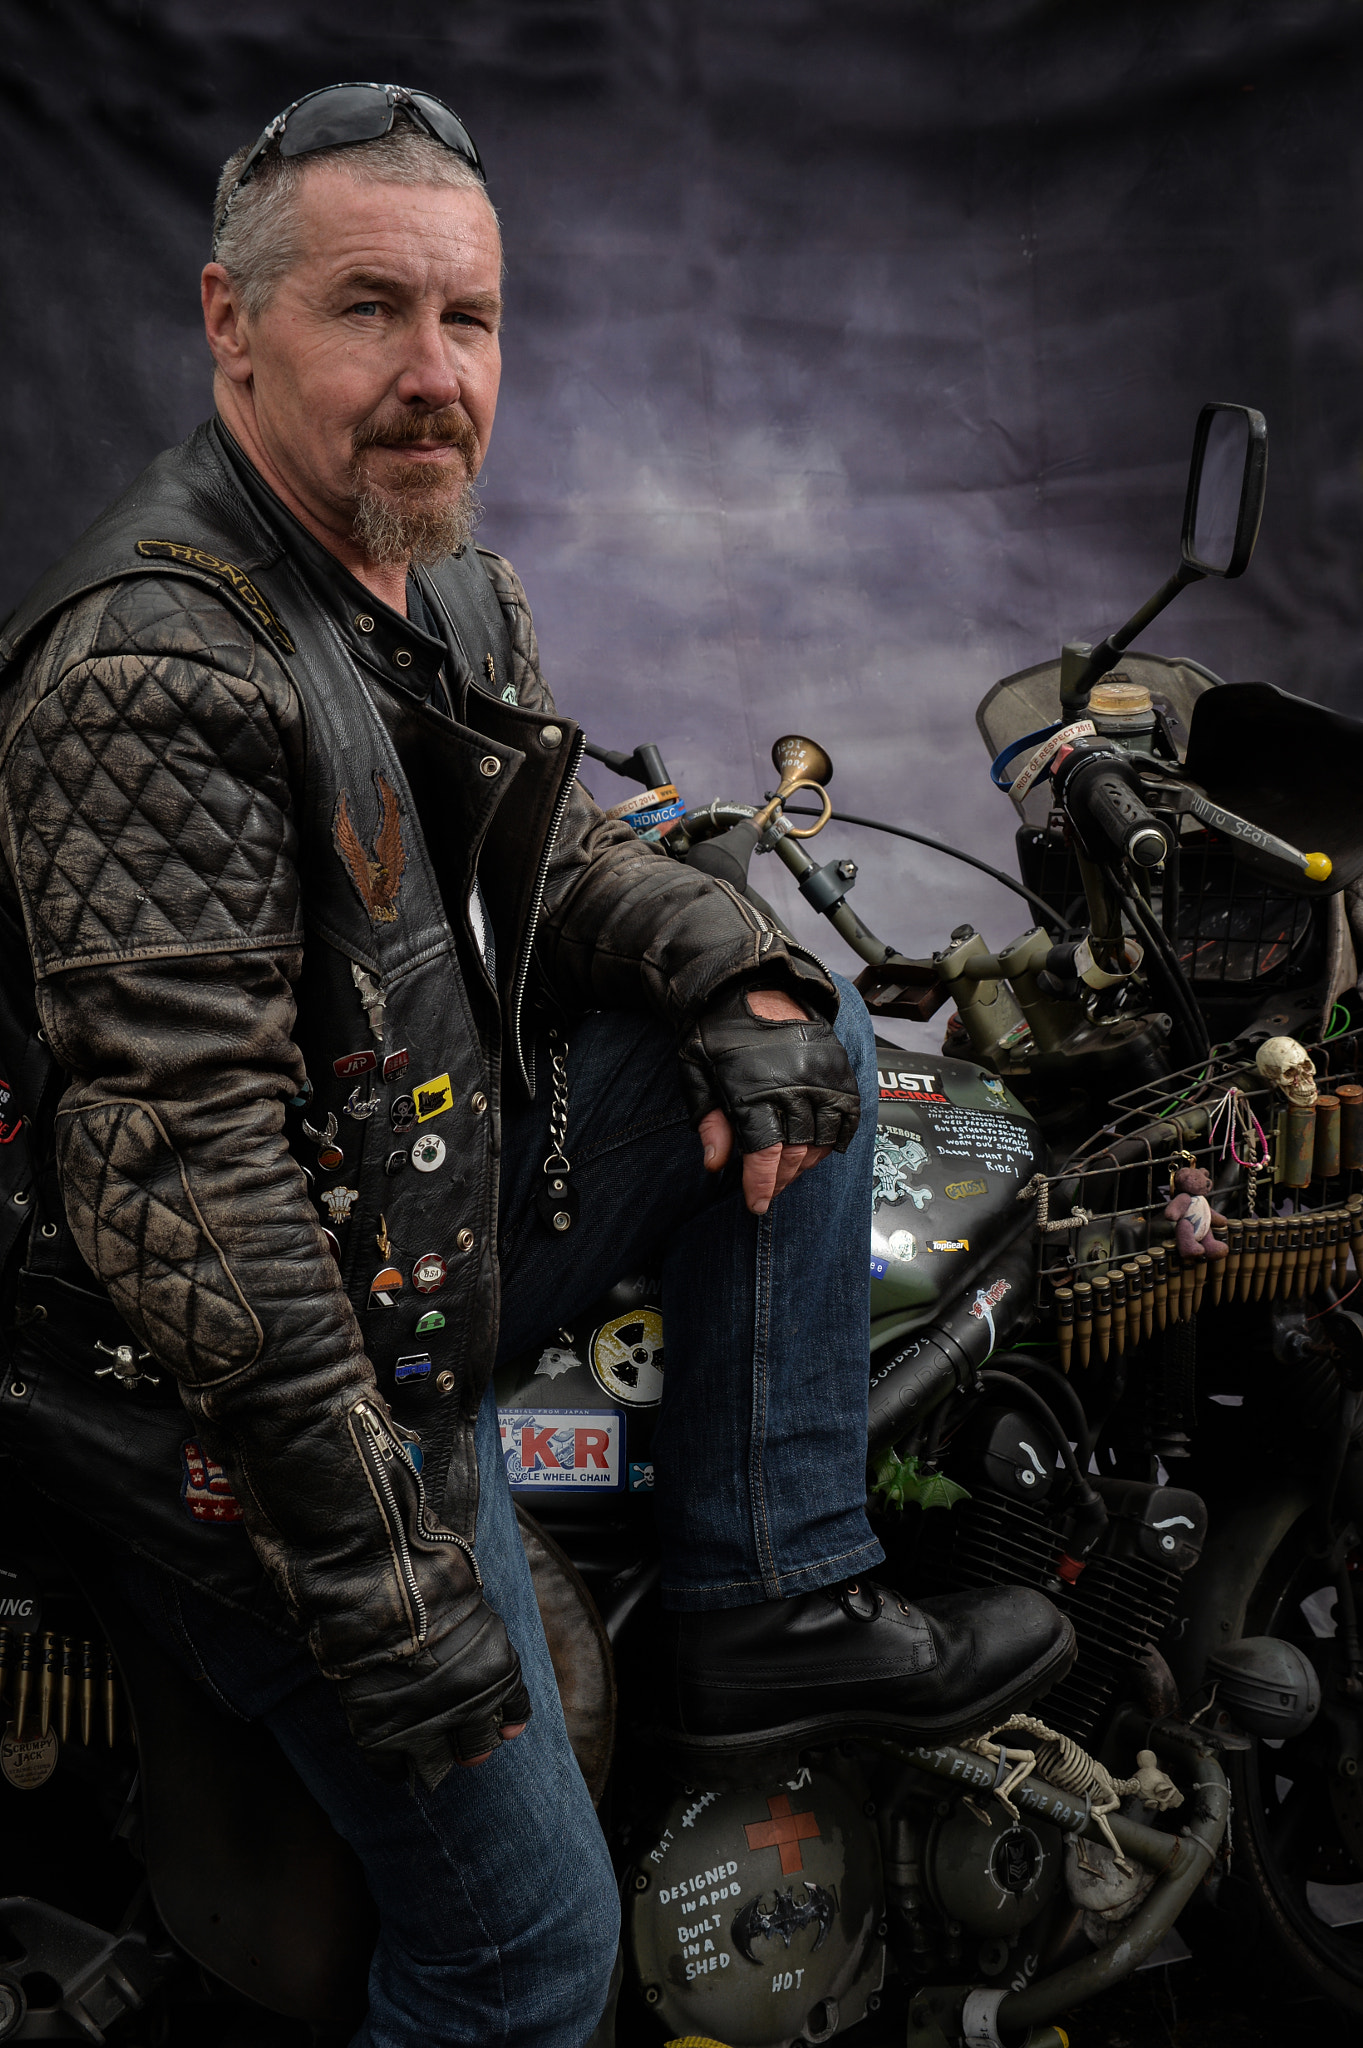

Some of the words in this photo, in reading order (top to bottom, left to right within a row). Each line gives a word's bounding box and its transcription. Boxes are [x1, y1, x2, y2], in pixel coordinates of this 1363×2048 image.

[169, 546, 271, 626] HONDA
[784, 750, 807, 759] THE
[1016, 772, 1032, 790] RIDE
[1030, 758, 1040, 772] OF
[1039, 728, 1074, 760] RESPECT
[633, 807, 677, 826] HDMCC
[342, 1057, 367, 1073] JAP
[878, 1089, 947, 1103] ACING
[885, 1125, 922, 1142] HEROES
[414, 1138, 440, 1158] OSSA
[1006, 1153, 1014, 1162] A
[543, 1473, 577, 1482] WHEEL
[579, 1473, 610, 1482] CHAIN
[3, 1738, 53, 1758] SCRUMPY
[13, 1750, 44, 1768] JACK
[949, 1759, 992, 1788] FEED
[1021, 1788, 1048, 1810] THE
[1052, 1800, 1086, 1826] RAT
[650, 1829, 675, 1864] RAT
[659, 1860, 738, 1905] DESIGNED
[681, 1899, 697, 1915] IN
[699, 1894, 709, 1907] A
[711, 1881, 742, 1906] PUB
[677, 1914, 721, 1944] BUILT
[704, 1938, 715, 1952] A
[685, 1952, 731, 1981] SHED
[771, 1968, 805, 1993] HOT
